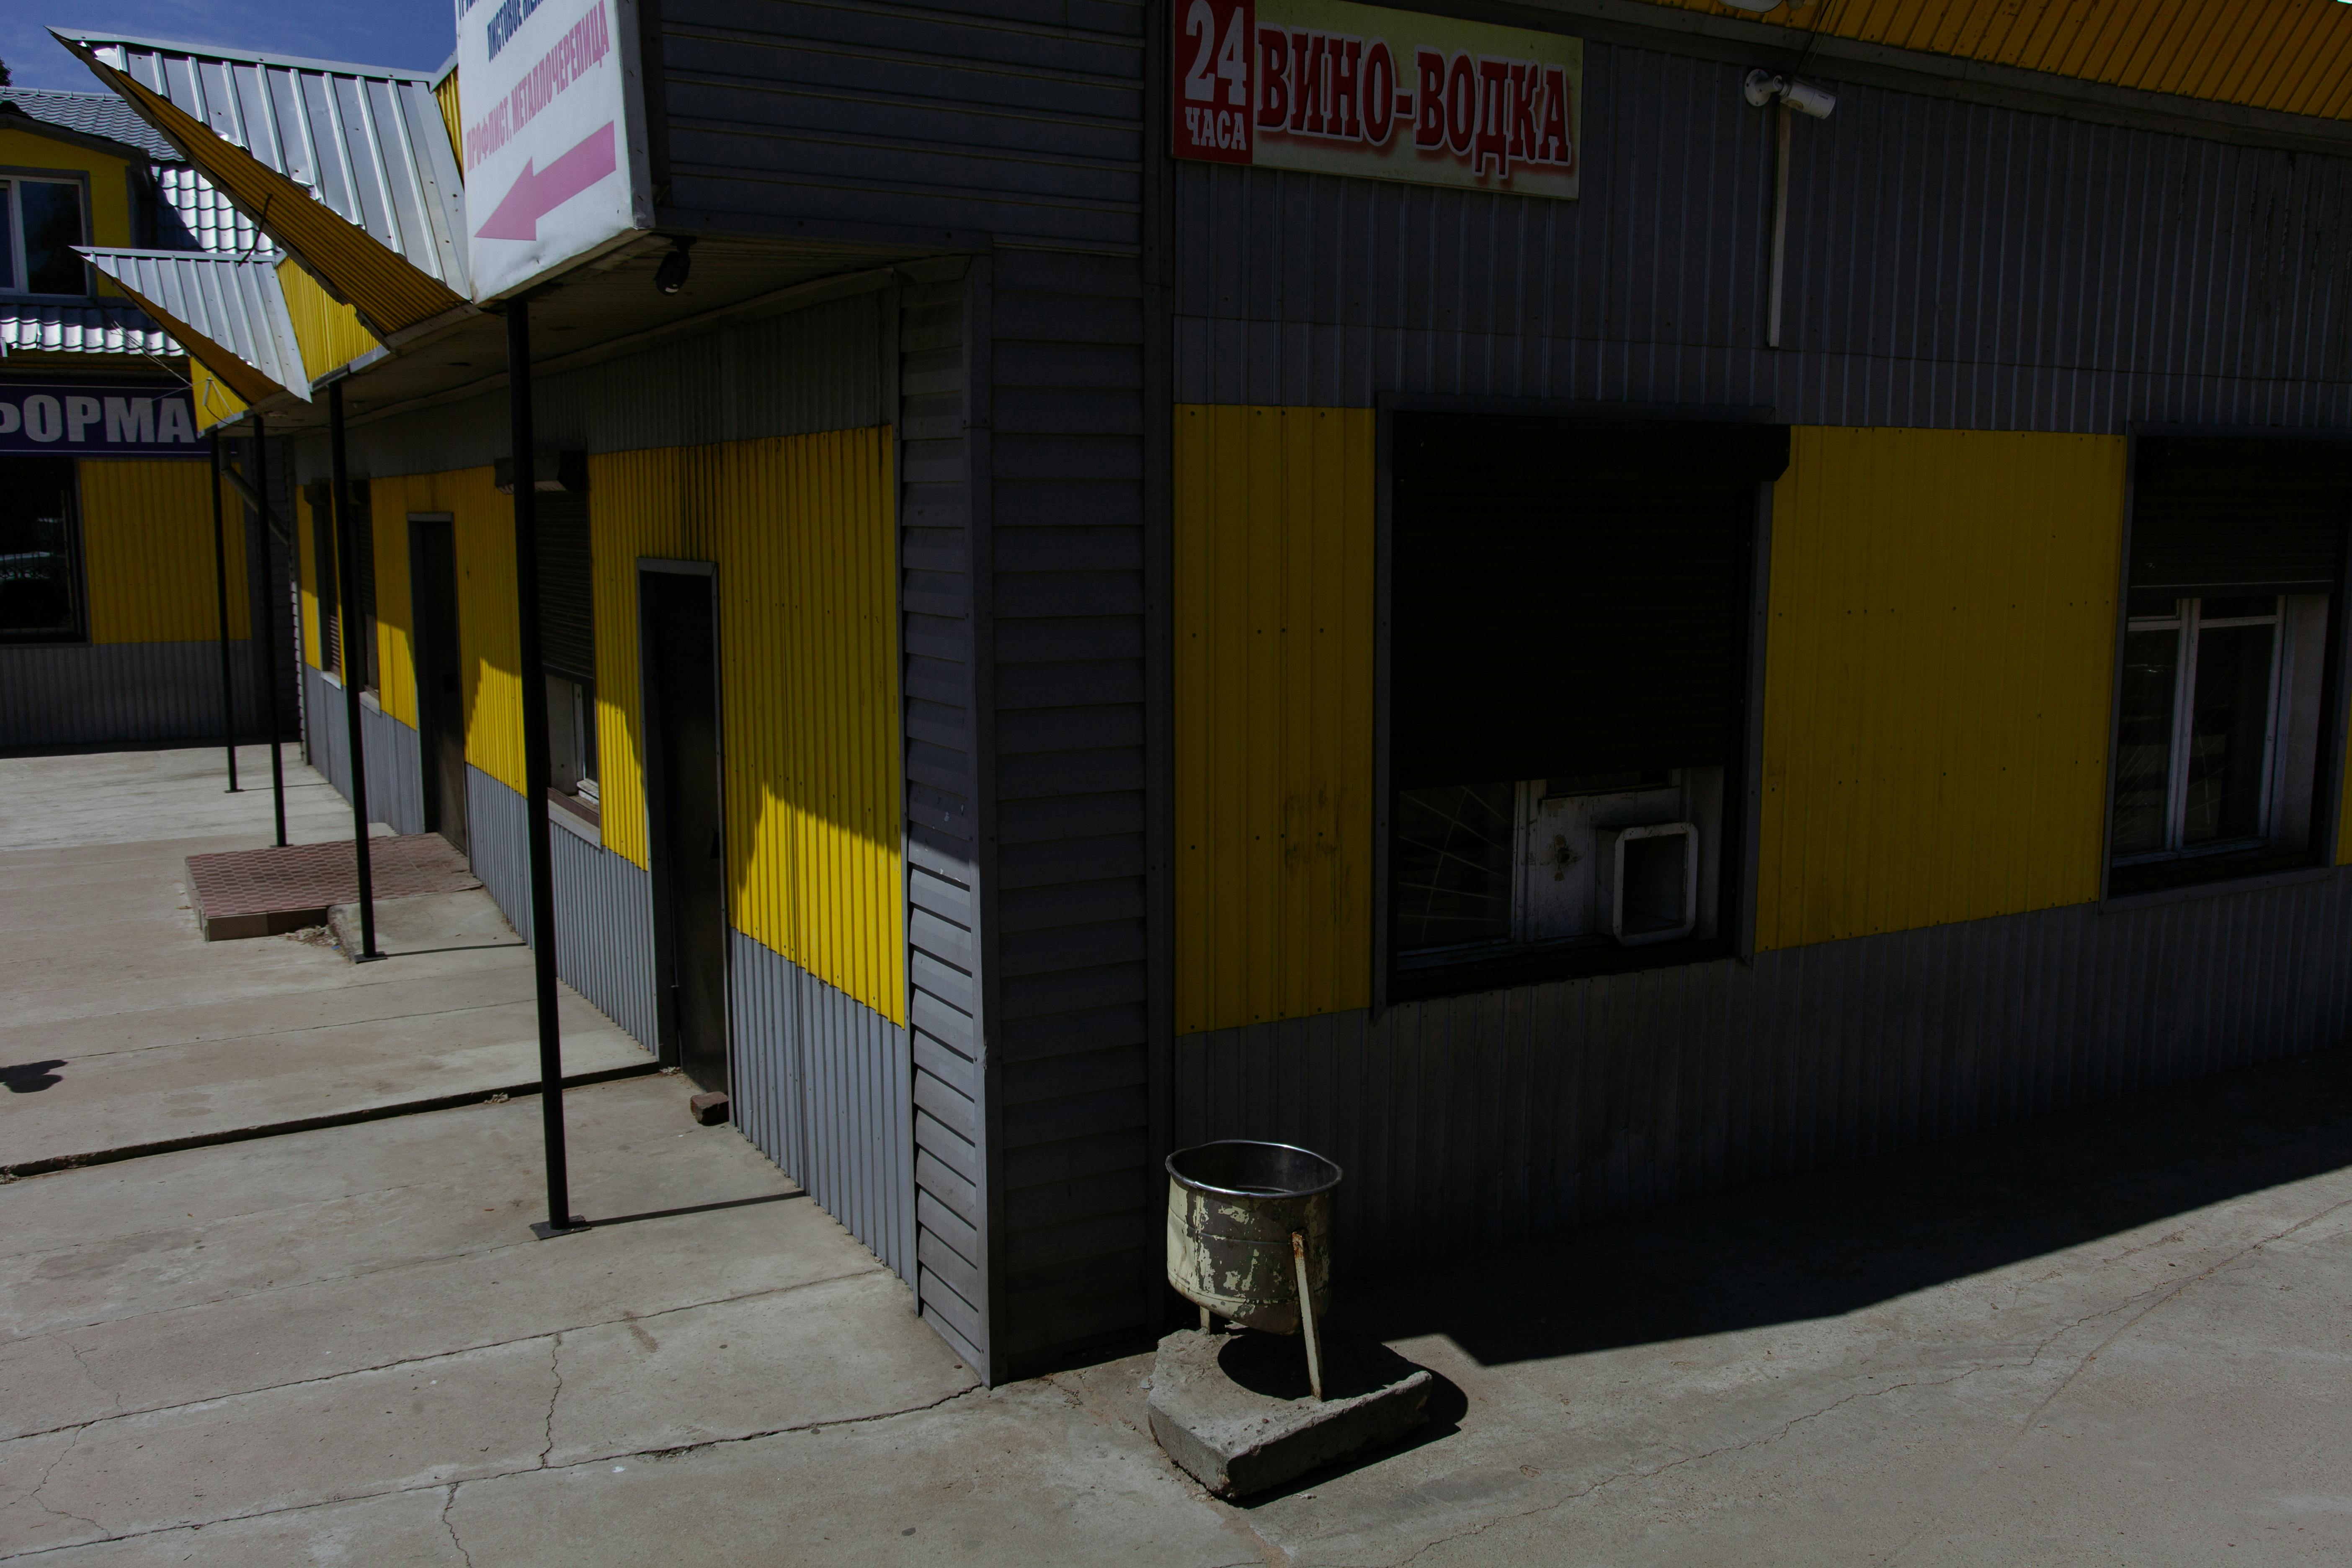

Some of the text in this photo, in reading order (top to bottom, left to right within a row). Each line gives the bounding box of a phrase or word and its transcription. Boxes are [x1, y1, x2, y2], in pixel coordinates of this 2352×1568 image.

[467, 0, 610, 173] ПРОФЛИСТ, МЕТАЛЛОЧЕРЕПИЦА
[1185, 0, 1247, 106] 24
[1256, 25, 1570, 178] ВИНО-ВОДКА
[1185, 106, 1246, 151] ЧАСА
